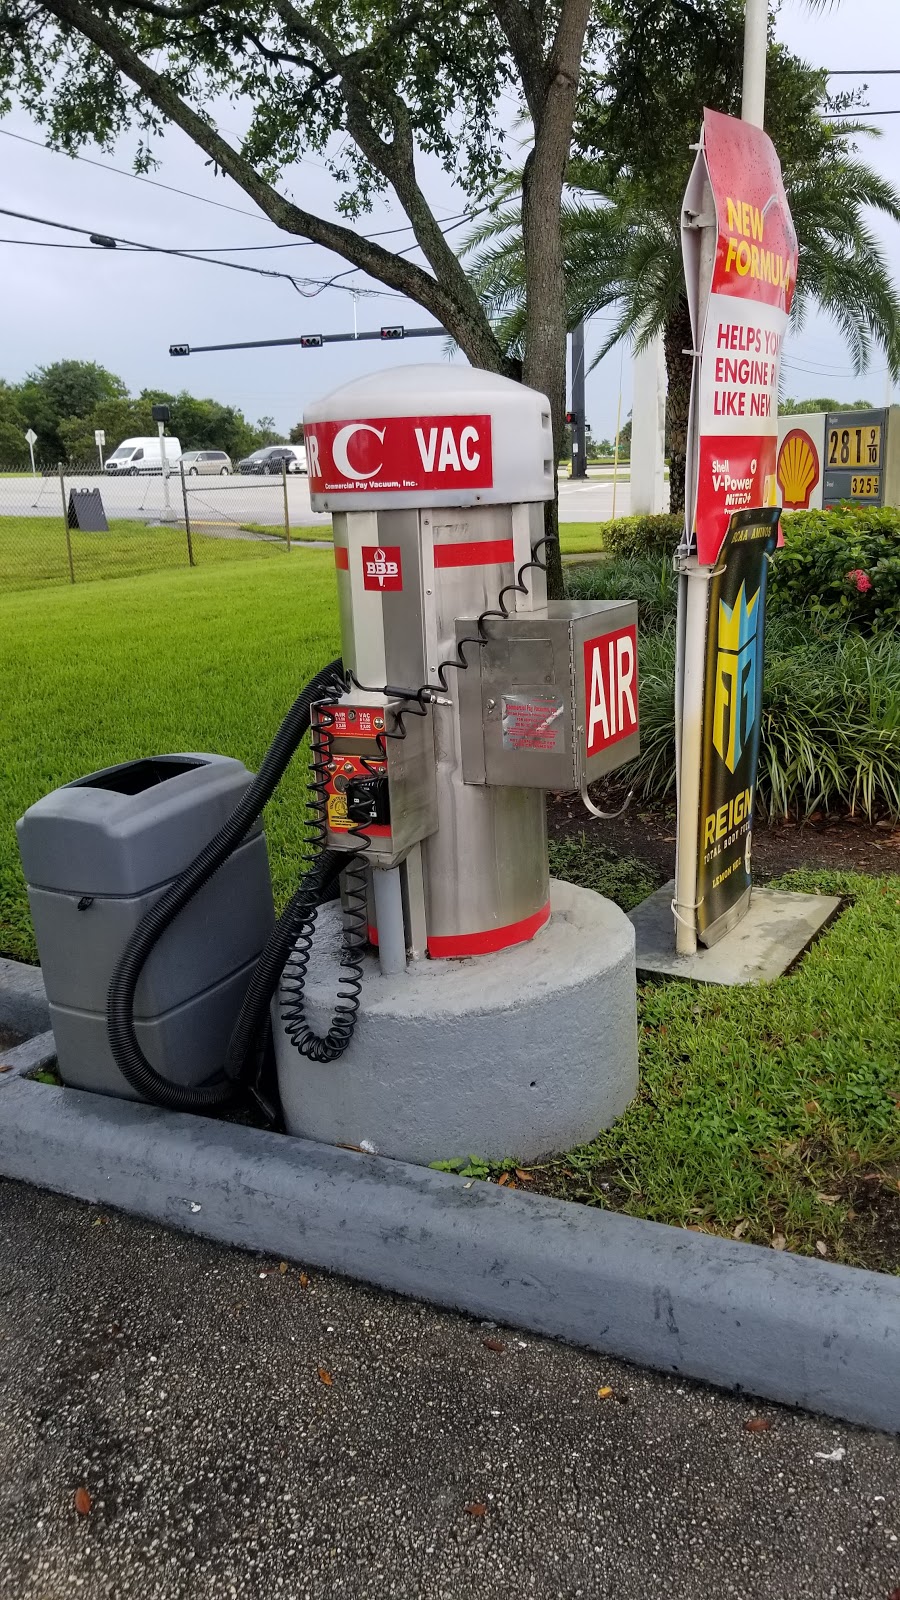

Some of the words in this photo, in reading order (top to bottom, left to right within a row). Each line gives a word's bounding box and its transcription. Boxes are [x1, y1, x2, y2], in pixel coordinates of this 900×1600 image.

[726, 197, 764, 243] NEW
[725, 237, 790, 292] FORMULA
[717, 323, 761, 353] HELPS
[715, 357, 768, 385] ENGINE
[714, 391, 746, 416] LIKE
[304, 435, 322, 478] IR
[414, 426, 481, 473] VAC
[829, 430, 861, 463] 281
[712, 460, 729, 473] Shell
[355, 481, 368, 490] Pay
[369, 480, 401, 489] Vacuum,
[712, 475, 754, 491] V-Power
[852, 478, 872, 493] 325
[366, 562, 398, 574] BBB
[587, 635, 637, 749] AIR
[704, 785, 753, 850] REIGN
[704, 844, 721, 865] TOTAL
[723, 830, 739, 849] BODY
[712, 866, 732, 888] LEMON
